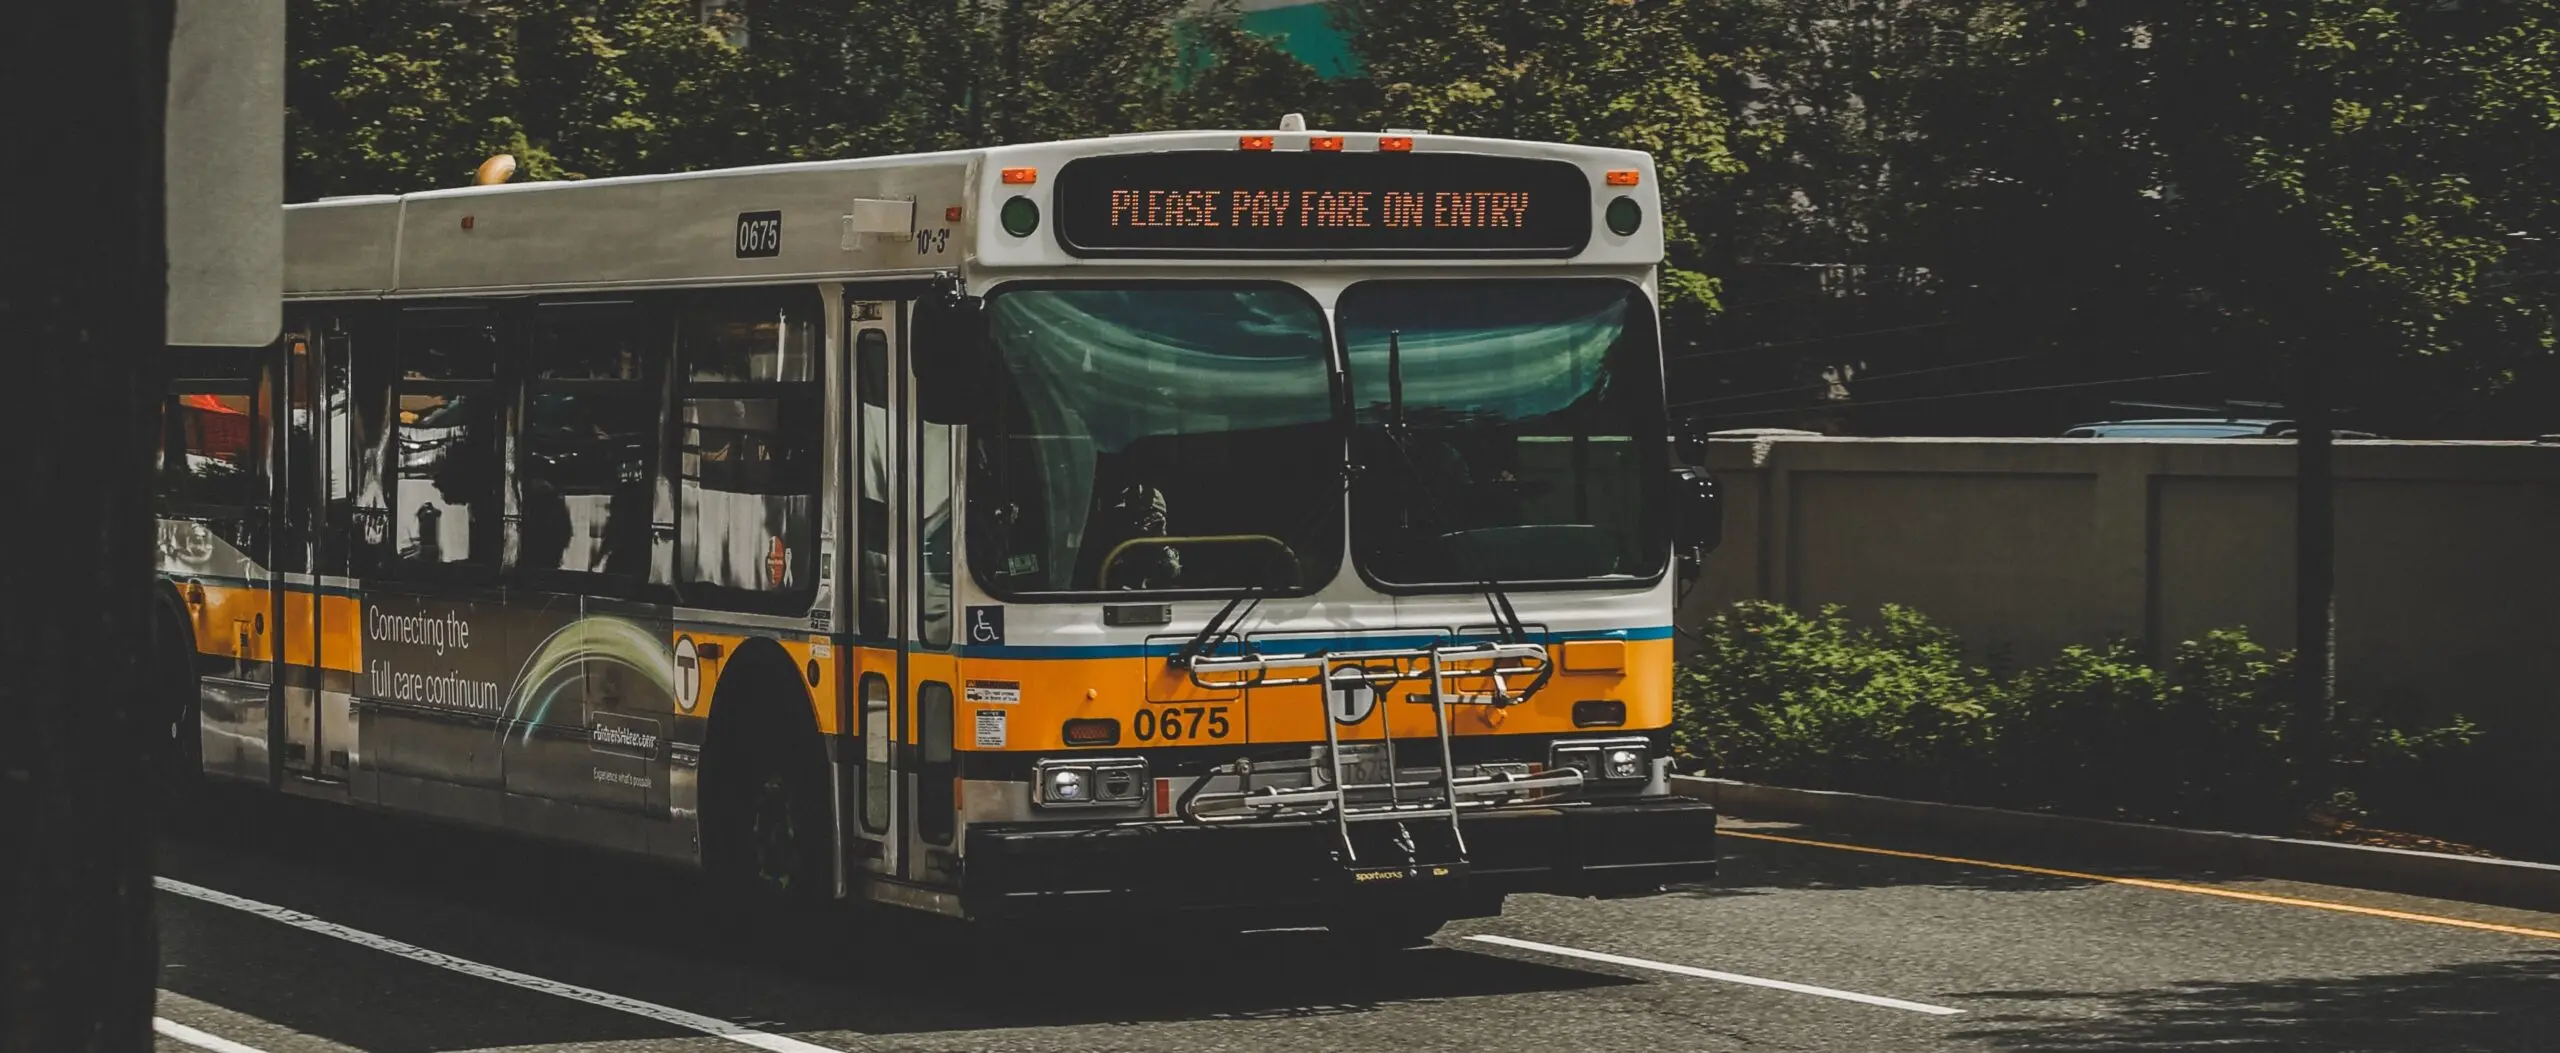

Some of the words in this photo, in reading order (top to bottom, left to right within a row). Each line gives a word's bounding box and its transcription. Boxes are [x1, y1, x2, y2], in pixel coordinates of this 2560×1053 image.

[1111, 189, 1220, 226] PLEASE
[1231, 190, 1290, 227] PAY
[1301, 190, 1371, 227] FARE
[1383, 191, 1424, 228] ON
[1434, 191, 1528, 228] ENTRY
[739, 219, 778, 251] 0675
[369, 605, 445, 655] Connecting
[447, 612, 469, 648] the
[371, 659, 391, 699] full
[393, 670, 422, 702] care
[425, 668, 502, 712] continuum.
[677, 655, 695, 701] T
[1331, 680, 1366, 716] T
[1133, 706, 1230, 741] 0675
